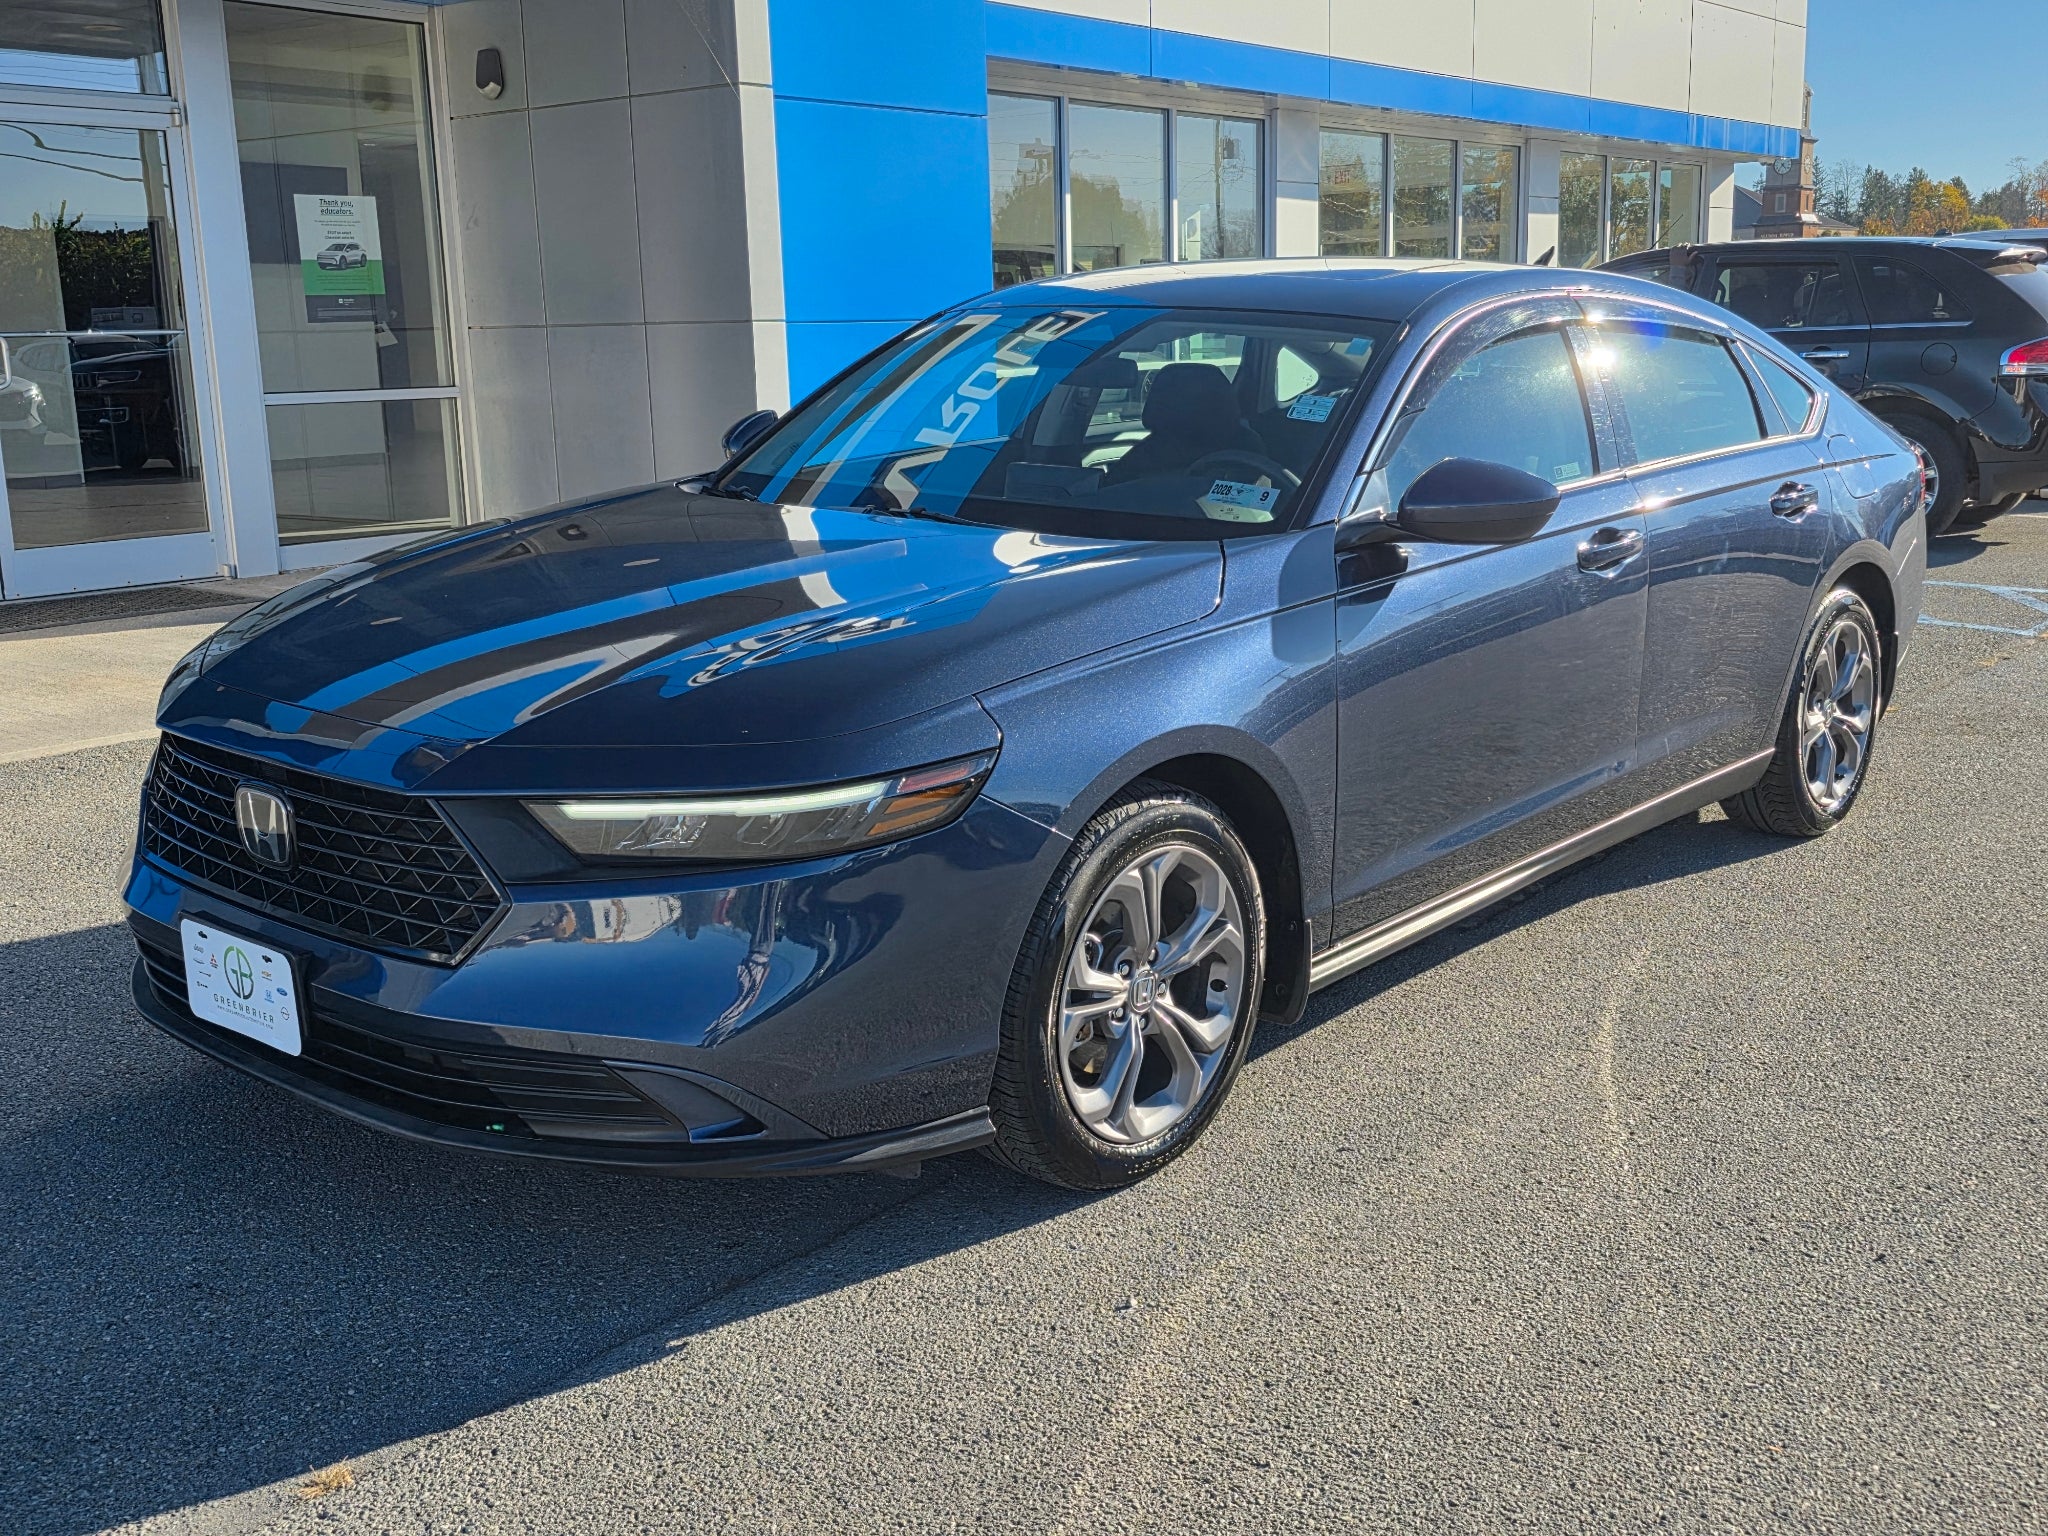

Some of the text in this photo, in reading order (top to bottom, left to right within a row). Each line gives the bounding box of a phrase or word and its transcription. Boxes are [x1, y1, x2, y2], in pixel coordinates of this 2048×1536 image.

[319, 198, 354, 208] Thank you,
[320, 207, 354, 216] educators.
[1259, 491, 1270, 502] 9
[213, 993, 275, 1024] GREENBRIER
